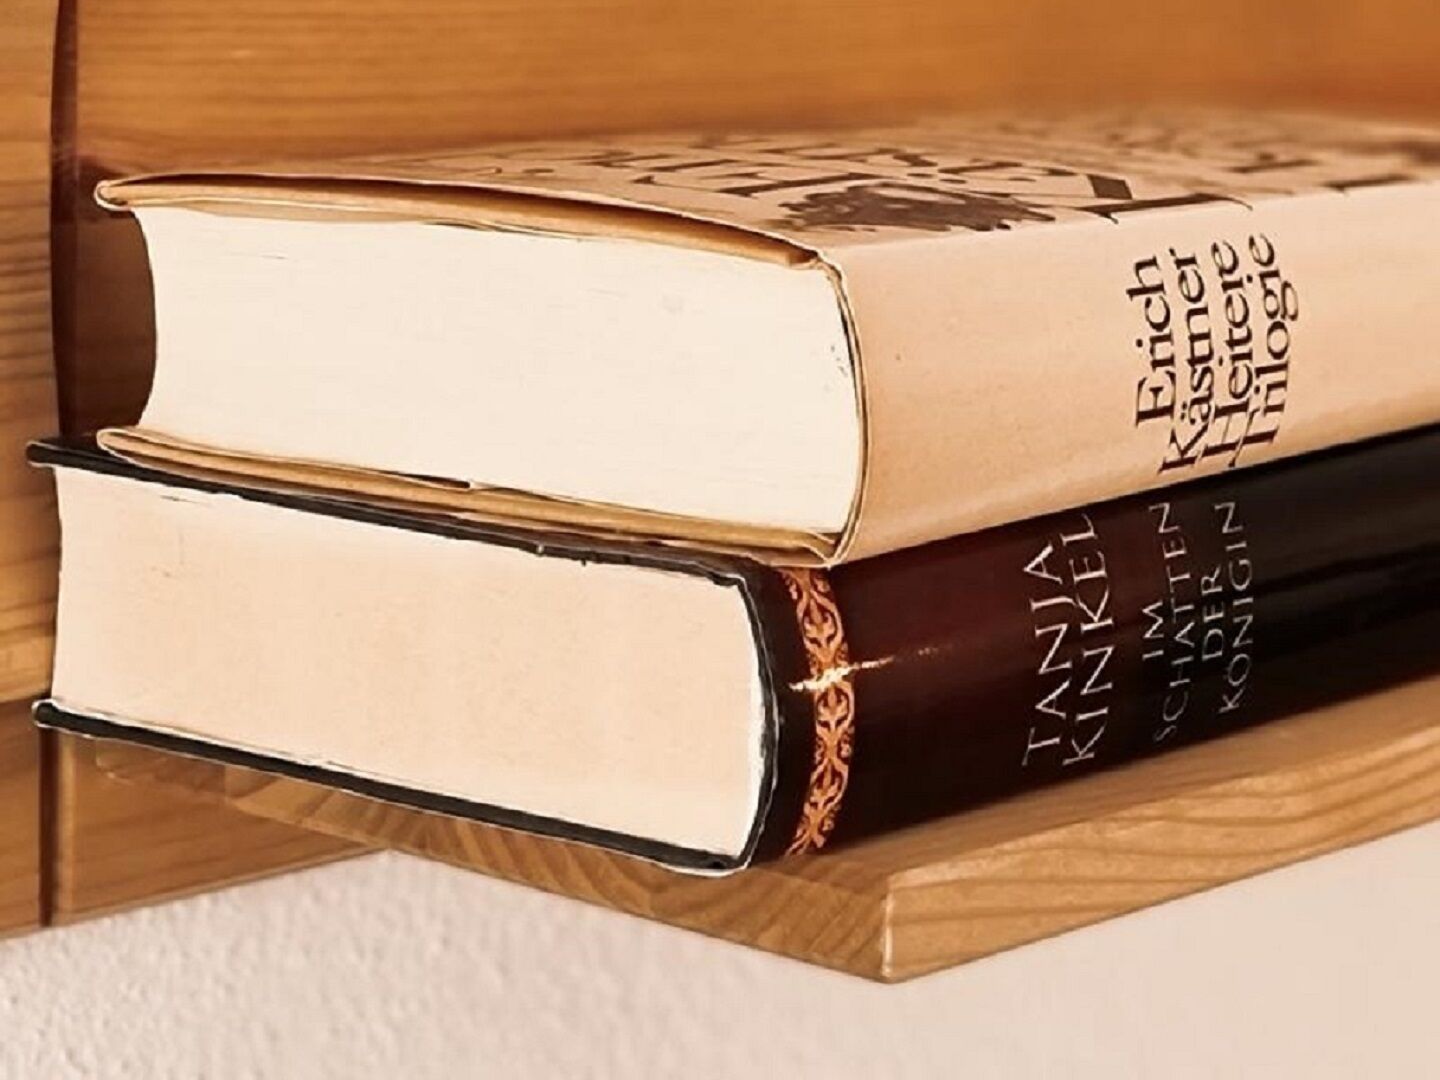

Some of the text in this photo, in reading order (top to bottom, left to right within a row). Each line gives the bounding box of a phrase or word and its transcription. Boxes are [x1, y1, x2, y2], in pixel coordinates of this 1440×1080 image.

[1126, 255, 1177, 428] Erich
[1156, 246, 1214, 475] Kästner
[1200, 239, 1254, 459] Heitere
[1227, 233, 1299, 468] Trilogie
[1021, 543, 1078, 766] TANJA
[1060, 513, 1115, 766] KINKEL
[1142, 600, 1165, 661] IM
[1149, 501, 1196, 742] SCHATTEN
[1201, 565, 1225, 661] DER
